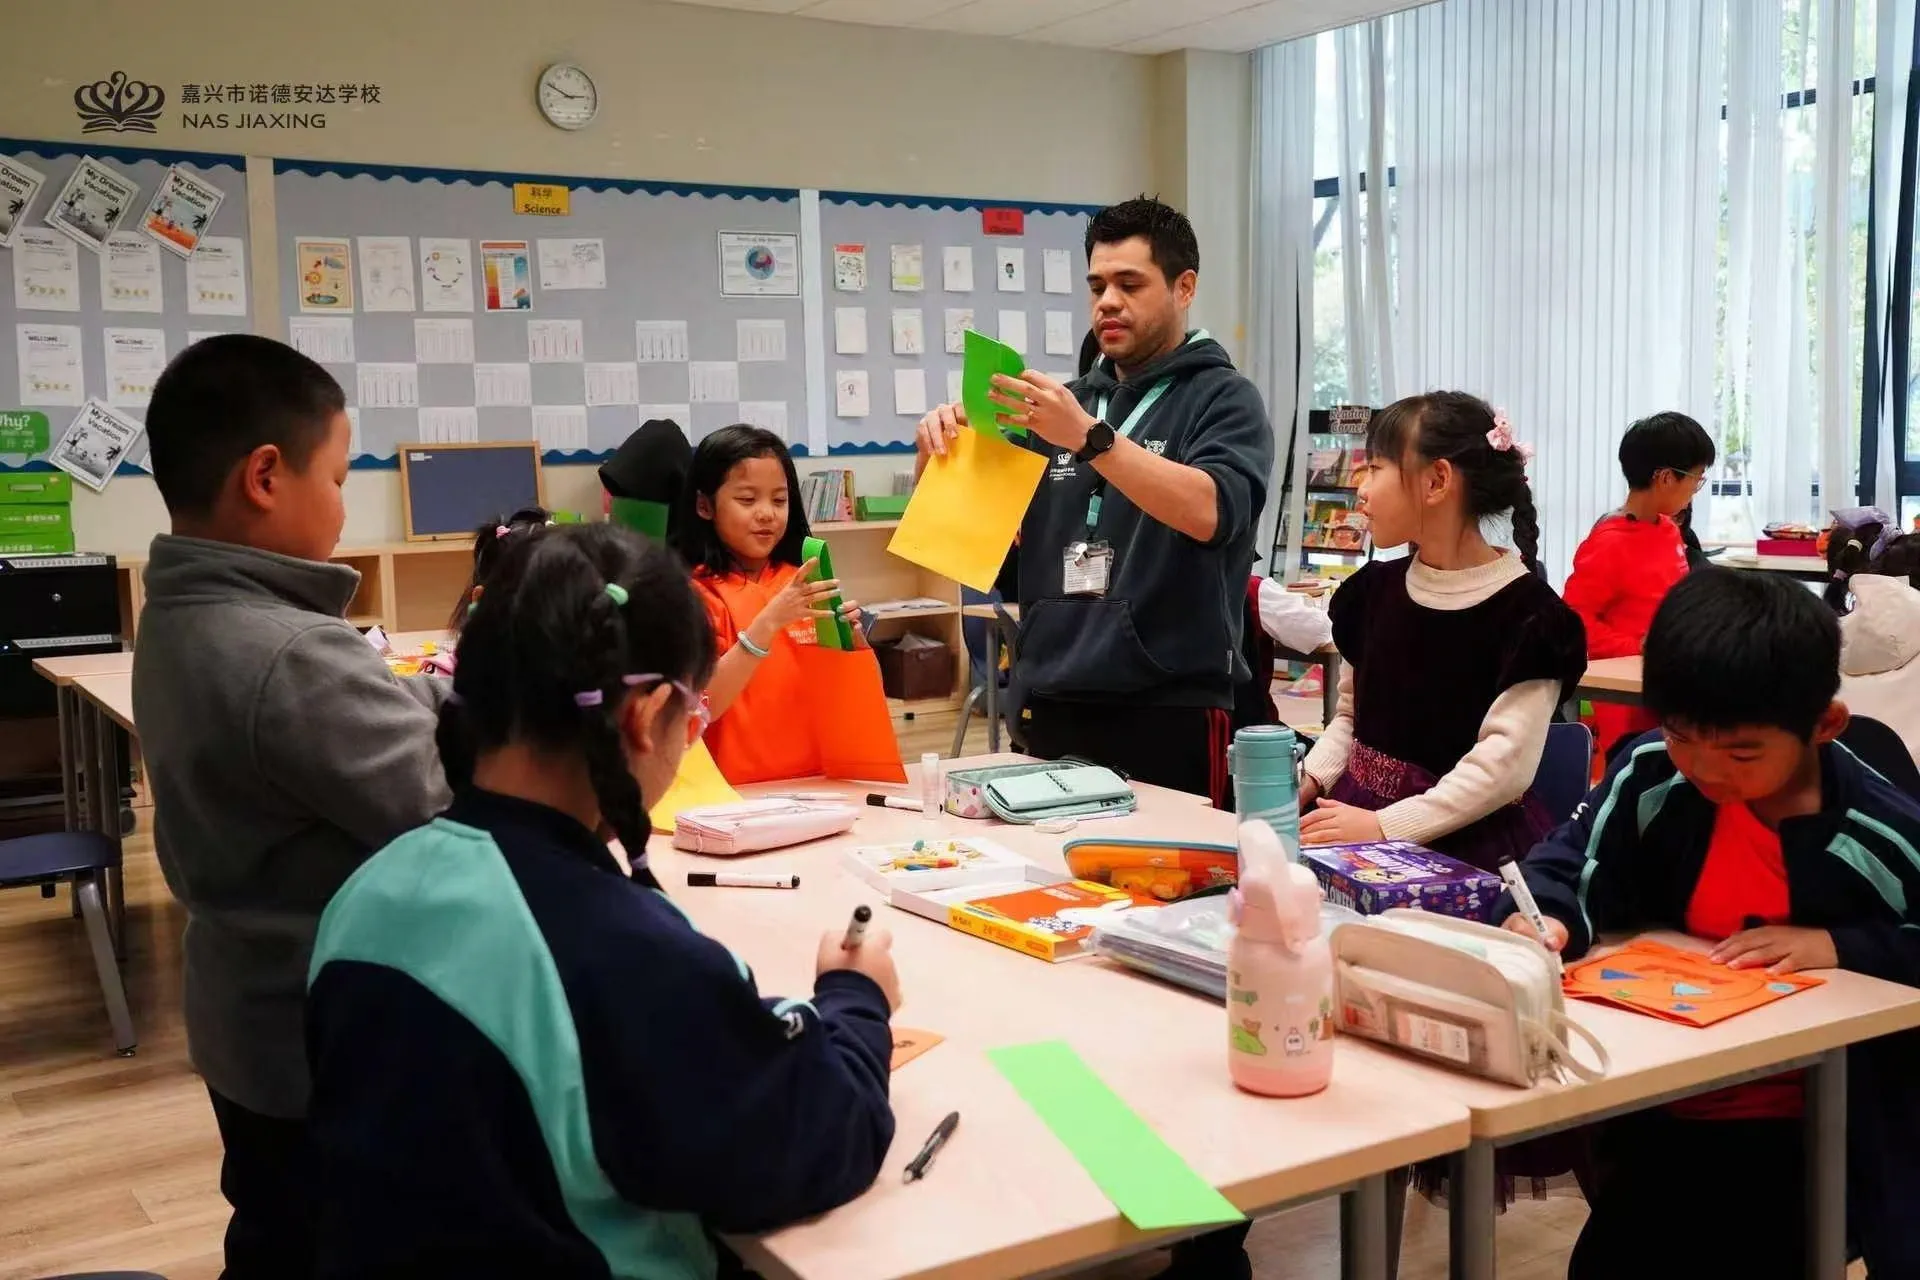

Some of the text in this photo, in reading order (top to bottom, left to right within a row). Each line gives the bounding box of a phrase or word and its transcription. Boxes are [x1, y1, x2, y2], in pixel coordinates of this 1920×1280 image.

[1, 167, 30, 188] Dream
[84, 176, 120, 203] Vacation
[86, 168, 126, 196] My Dream
[173, 175, 214, 202] My Dream
[171, 184, 207, 209] Vacation
[524, 203, 561, 214] Science
[88, 418, 121, 442] Vacation
[91, 408, 129, 435] My Dream
